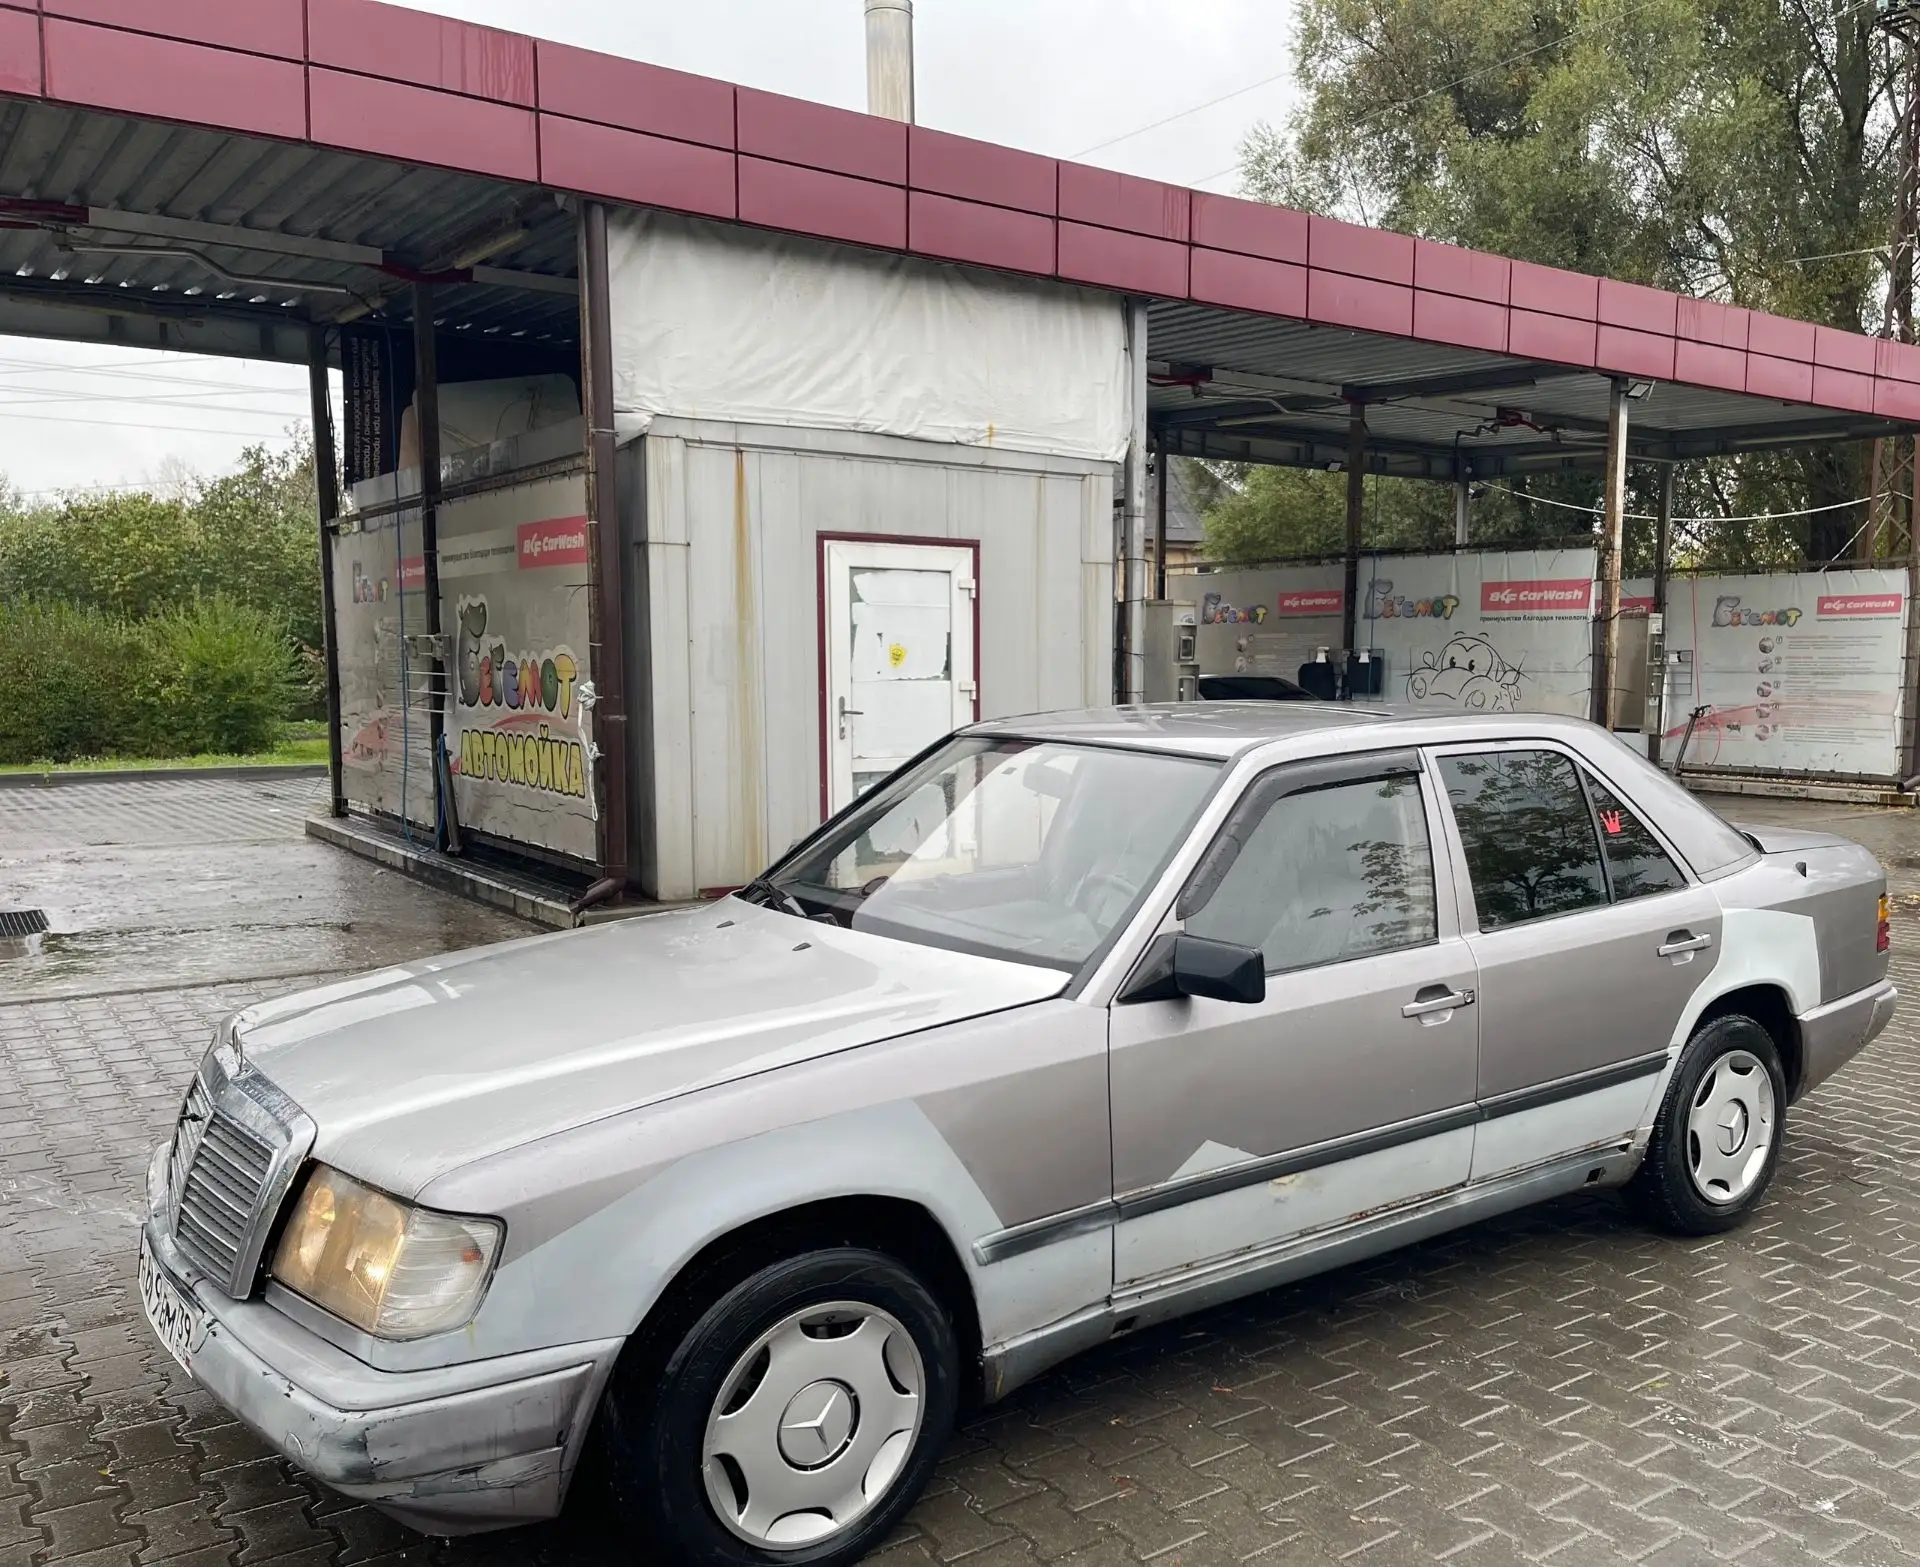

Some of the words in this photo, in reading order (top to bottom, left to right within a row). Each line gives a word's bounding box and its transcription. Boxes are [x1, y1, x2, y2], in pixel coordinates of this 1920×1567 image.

[542, 532, 585, 552] CarWash
[1519, 589, 1583, 601] CarWash
[1846, 599, 1895, 609] CarWash
[461, 724, 585, 798] АВТОМОЙКА
